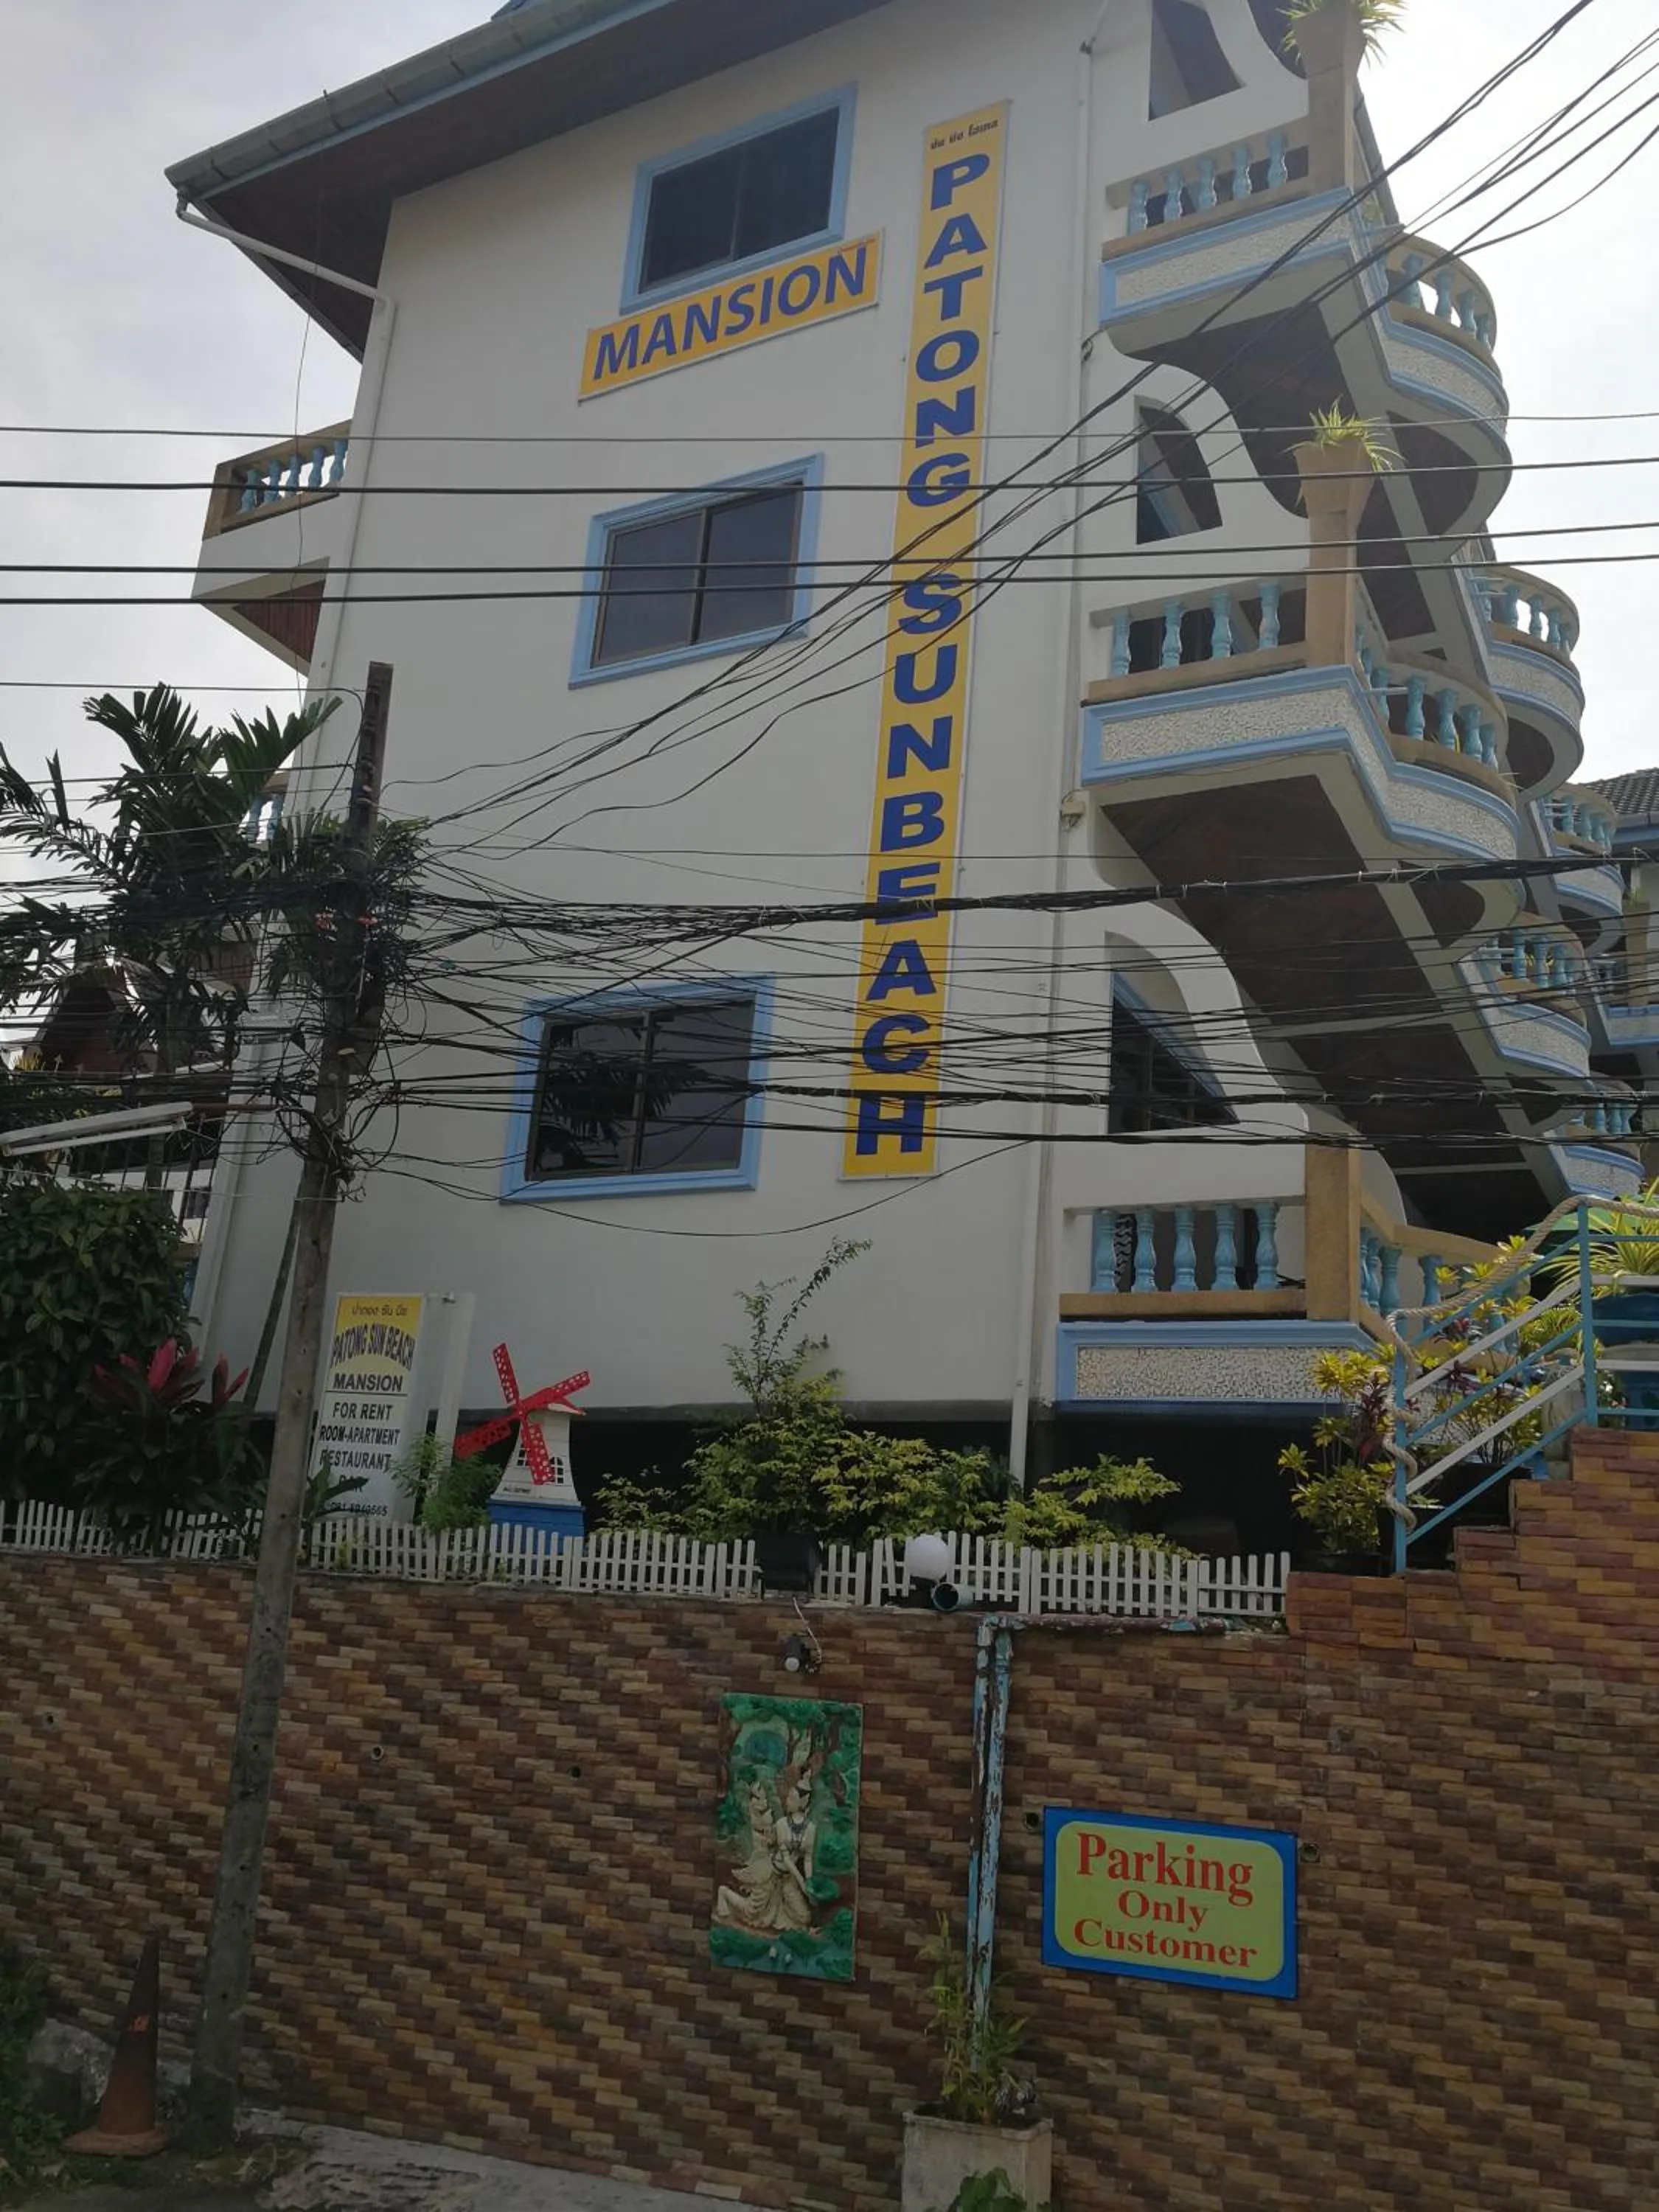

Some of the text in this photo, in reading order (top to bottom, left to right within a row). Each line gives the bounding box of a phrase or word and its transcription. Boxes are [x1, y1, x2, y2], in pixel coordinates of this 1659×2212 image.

[592, 245, 867, 380] MANSION
[905, 153, 990, 507] PATONG
[330, 1323, 416, 1371] PATONG SUN BEACH
[332, 1372, 404, 1392] MANSION
[319, 1425, 400, 1445] ROOM-APARTMENT
[333, 1402, 394, 1421] FOR RENT
[1076, 1832, 1254, 1907] Parking
[1118, 1889, 1209, 1933] Only
[1074, 1918, 1258, 1968] Customer
